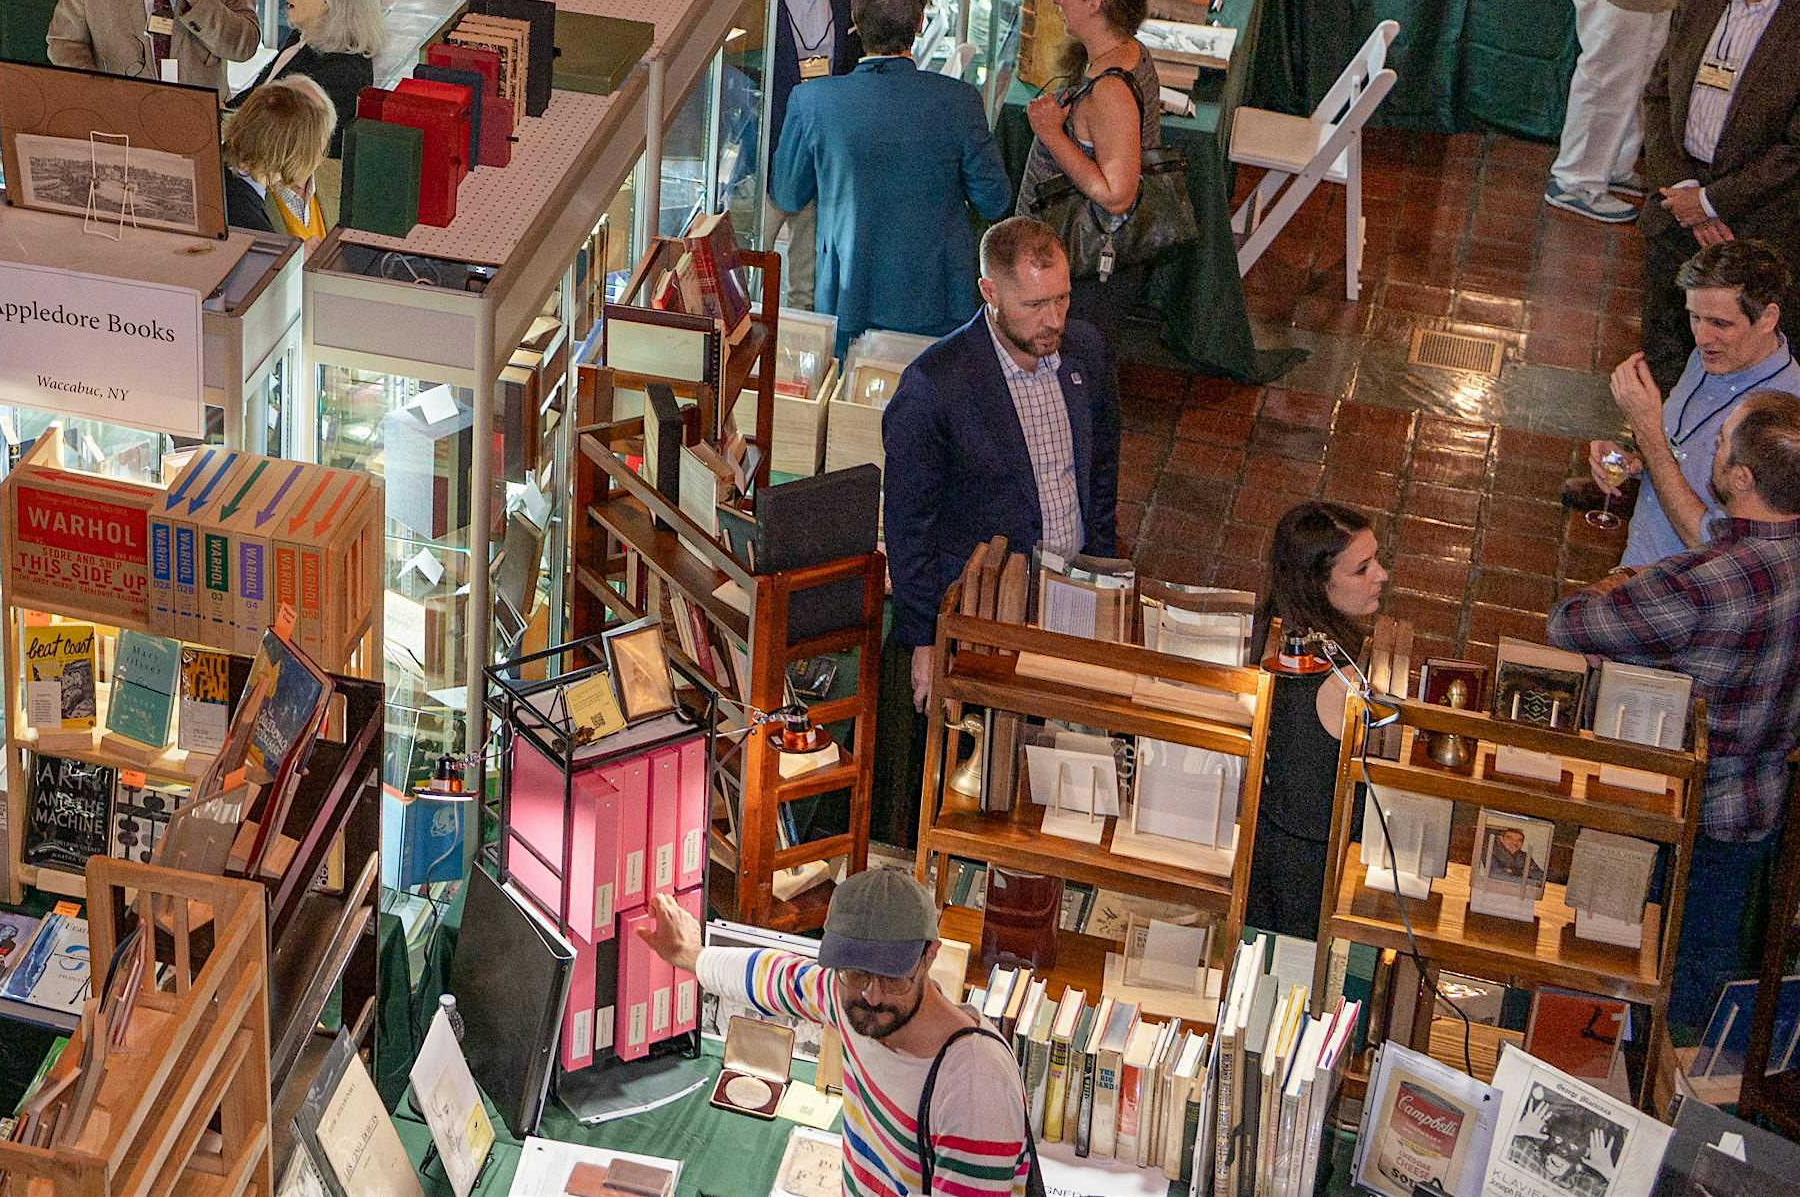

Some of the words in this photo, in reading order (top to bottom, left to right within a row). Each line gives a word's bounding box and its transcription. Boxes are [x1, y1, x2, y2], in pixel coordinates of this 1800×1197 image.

[107, 314, 176, 343] Books
[37, 374, 104, 399] Waccabuc,
[107, 387, 130, 402] NY
[27, 505, 137, 548] WARHOL
[42, 547, 73, 562] STORE
[78, 553, 95, 566] AND
[99, 558, 122, 571] SHIP
[155, 528, 169, 575] WARHOL
[179, 533, 192, 580] WARHOL
[210, 539, 224, 587] WARHOL
[18, 552, 61, 574] THIS
[71, 562, 113, 585] SIDE
[122, 572, 147, 591] UP
[245, 548, 258, 596] WARHOL
[280, 553, 293, 603] WARHOL
[304, 557, 317, 605] WARHOL
[211, 592, 224, 602] 03
[26, 638, 62, 660] beat
[62, 636, 96, 655] coast
[131, 645, 160, 662] Mary
[126, 657, 162, 676] Oliver
[40, 762, 86, 793] ART
[35, 806, 104, 836] MACHINE
[1395, 1158, 1431, 1181] CHEESE
